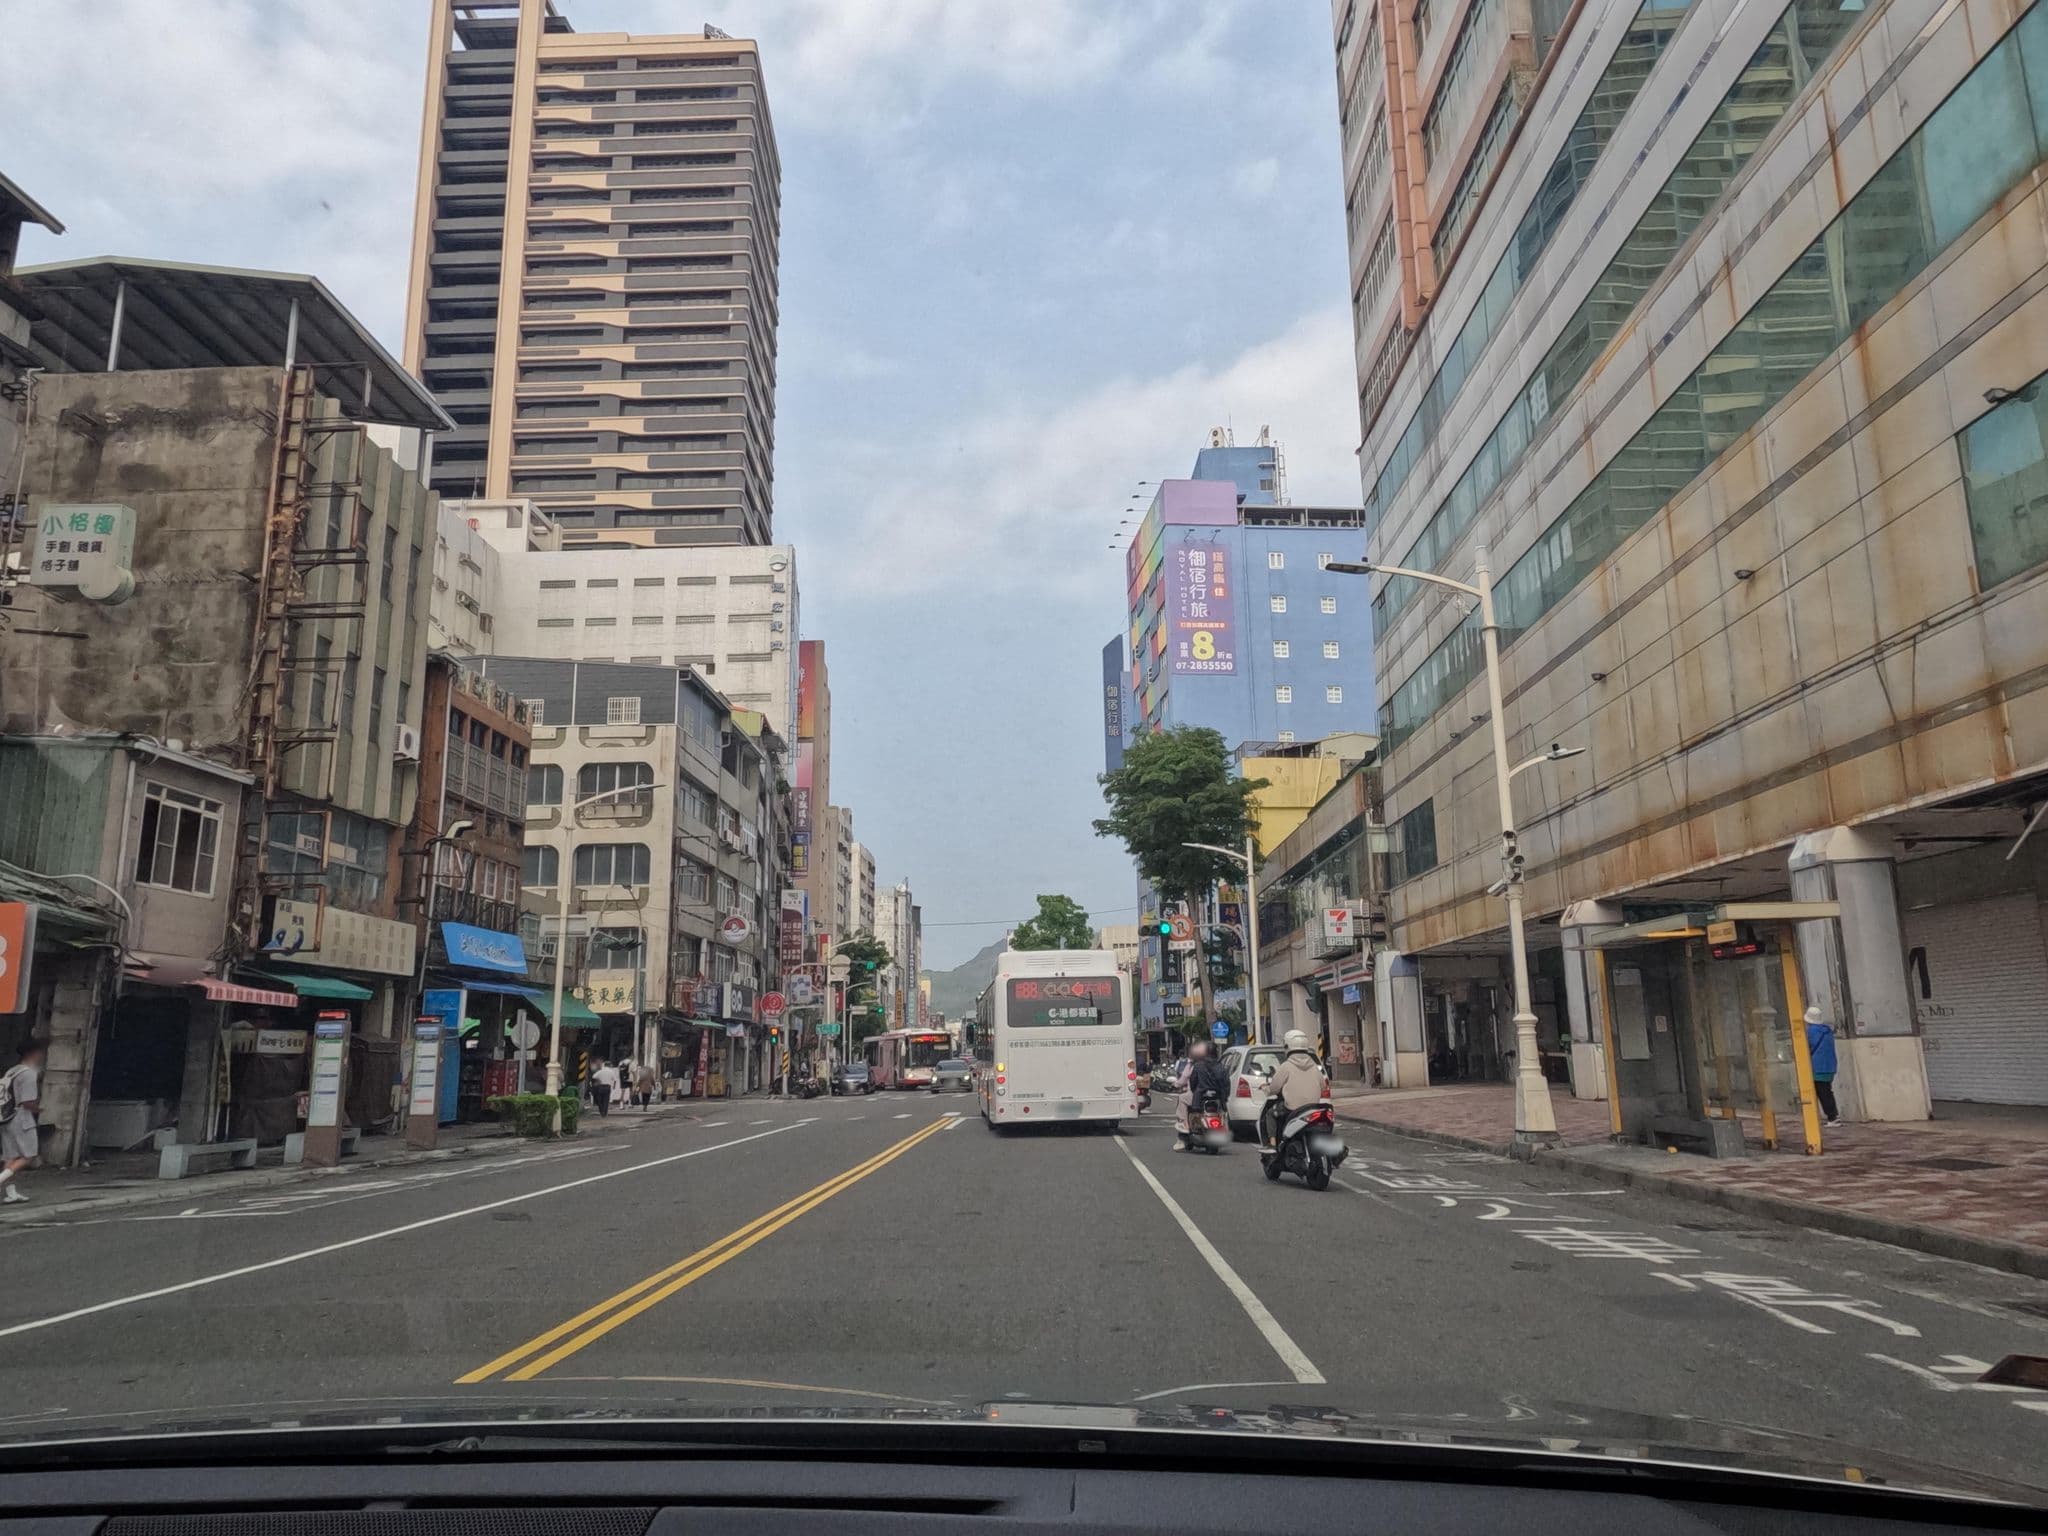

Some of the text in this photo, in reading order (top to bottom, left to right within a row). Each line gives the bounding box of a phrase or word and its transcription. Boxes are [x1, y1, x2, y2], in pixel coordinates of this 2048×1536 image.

[1188, 549, 1209, 618] 御宿行旅
[1181, 586, 1189, 618] HOTEL
[1175, 660, 1234, 671] 07-2855550
